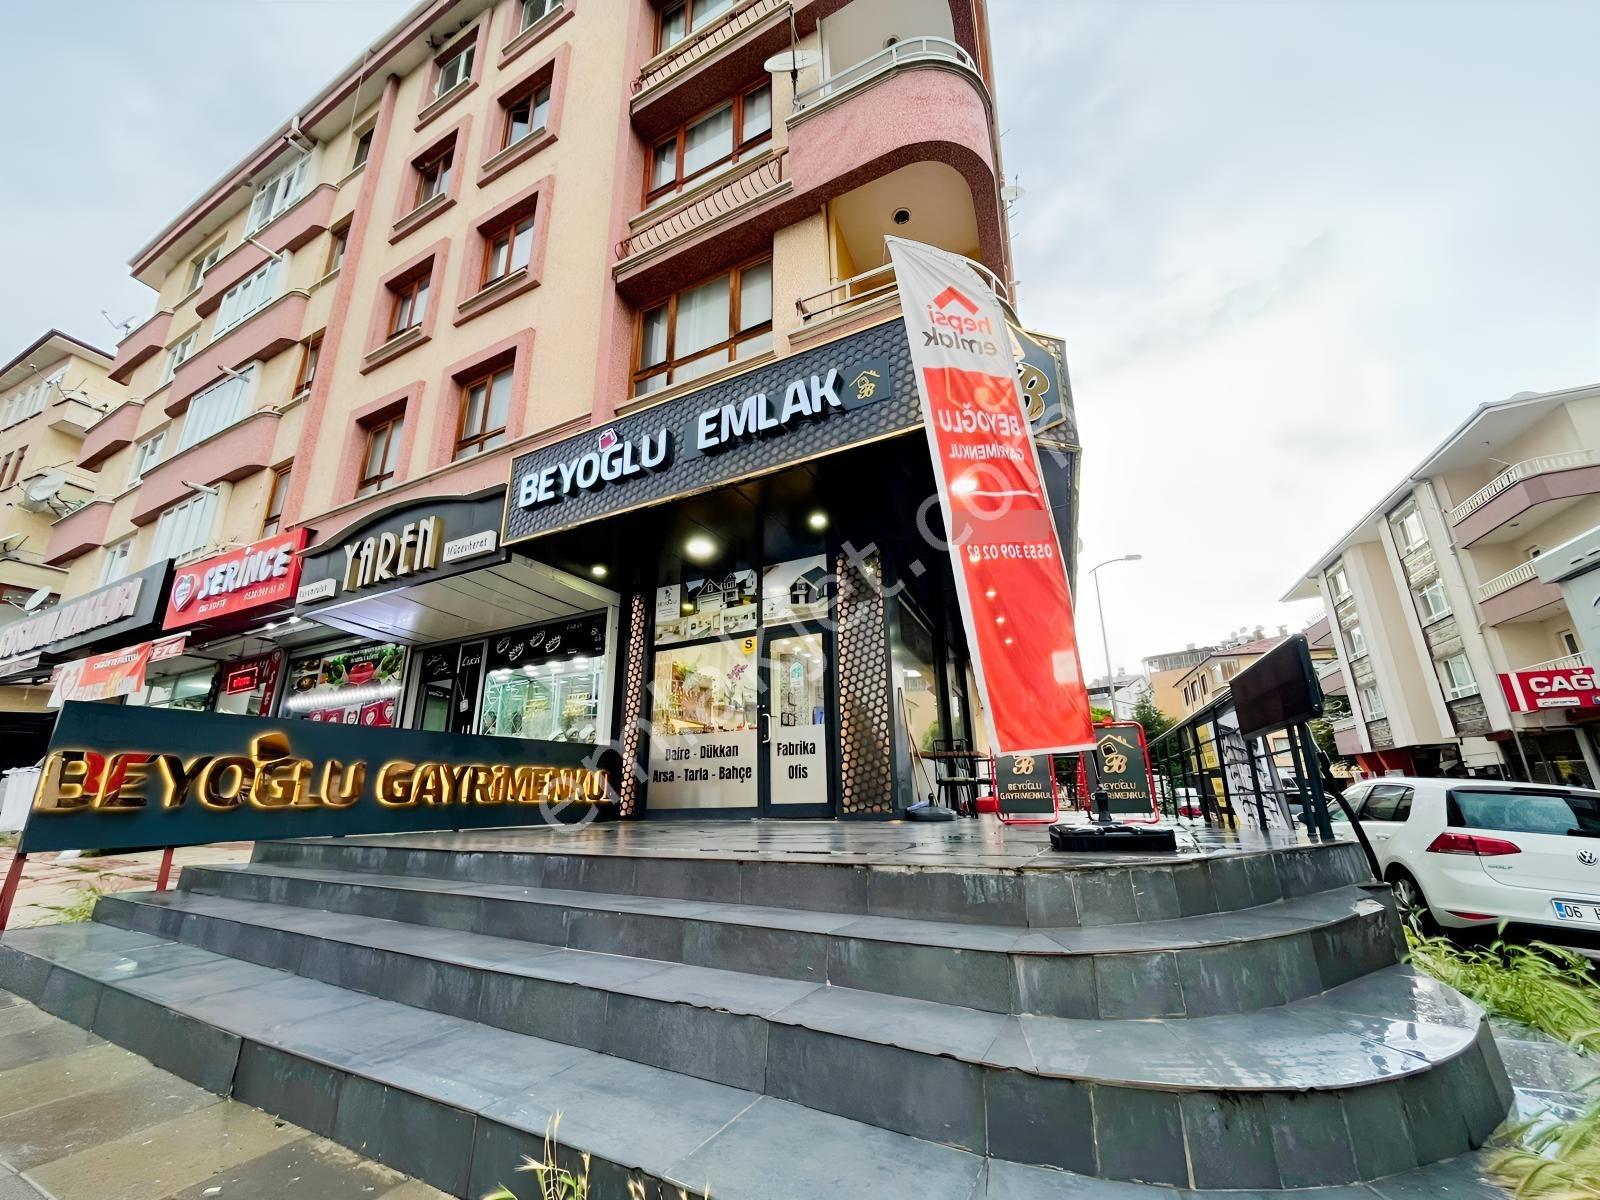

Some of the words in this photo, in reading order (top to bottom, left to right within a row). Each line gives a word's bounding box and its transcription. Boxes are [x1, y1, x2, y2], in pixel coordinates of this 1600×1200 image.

[697, 368, 843, 451] EMLAK
[342, 515, 442, 592] YAREN
[197, 542, 293, 600] SERİNCE
[665, 746, 691, 761] Daire
[700, 744, 739, 758] Dükkan
[776, 741, 816, 757] Fabrika
[652, 769, 675, 783] Arsa
[684, 767, 709, 782] Tarla
[718, 765, 752, 783] Bahçe
[788, 764, 808, 780] Ofis
[1565, 905, 1583, 919] 06
